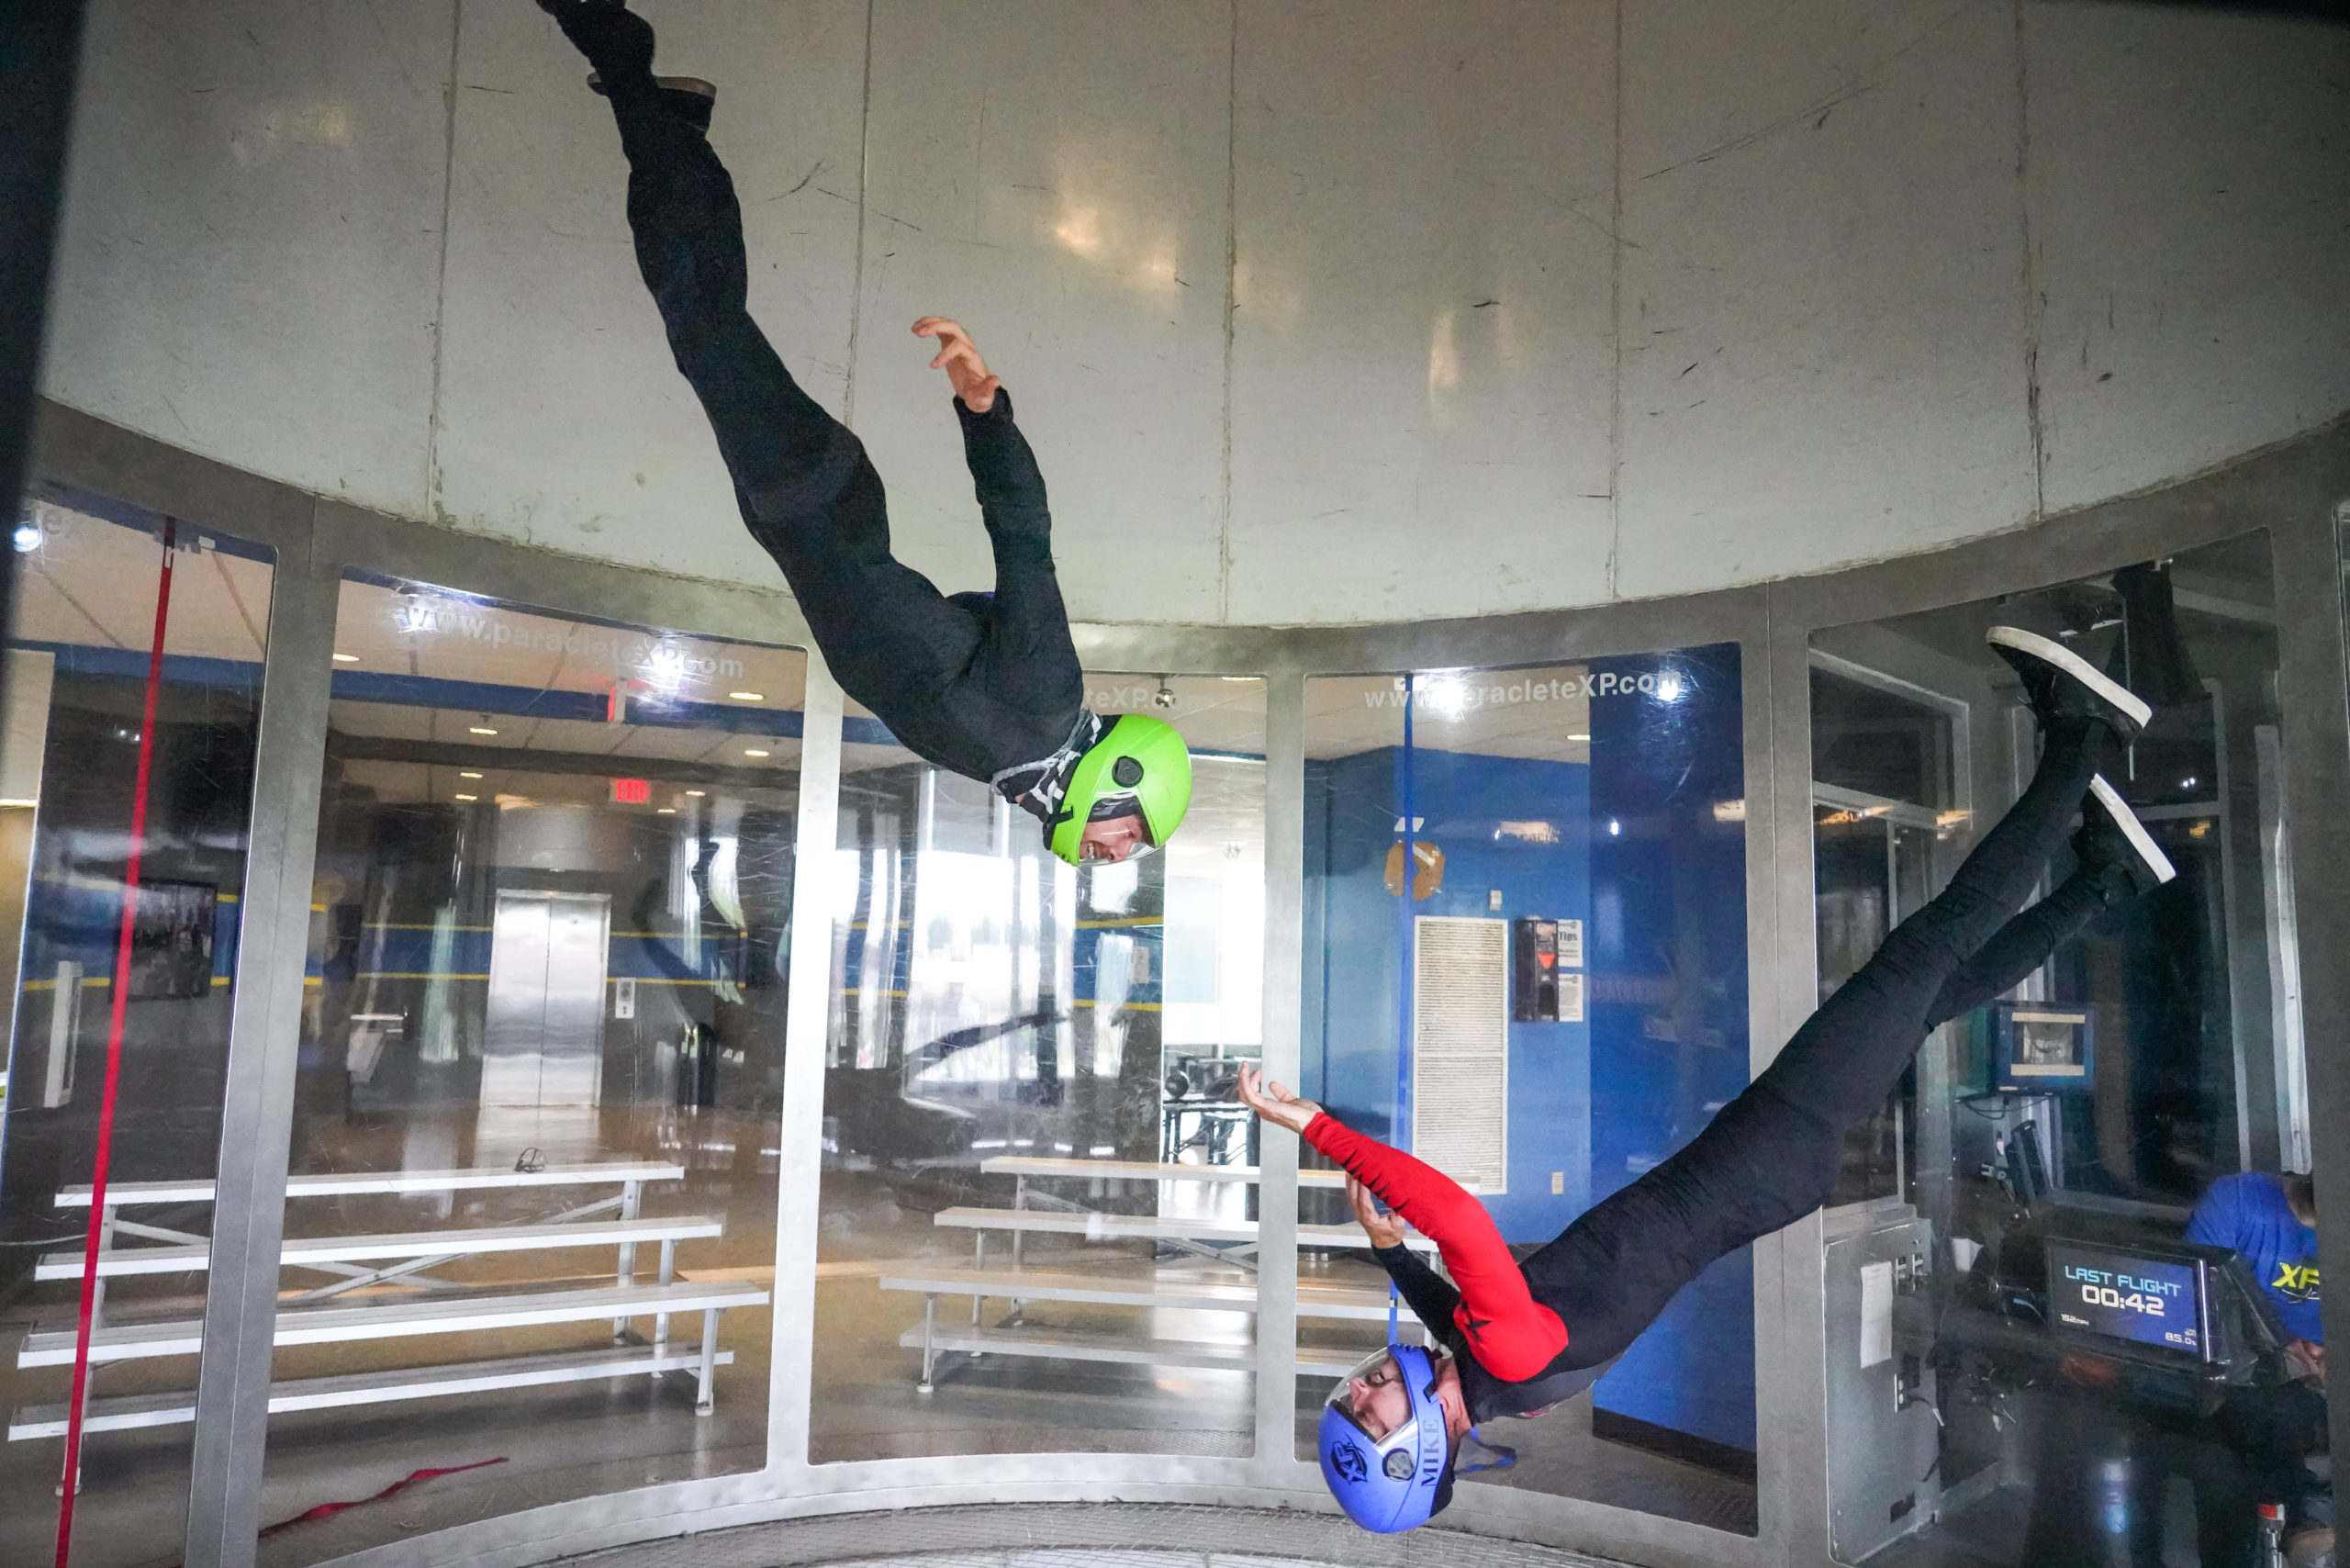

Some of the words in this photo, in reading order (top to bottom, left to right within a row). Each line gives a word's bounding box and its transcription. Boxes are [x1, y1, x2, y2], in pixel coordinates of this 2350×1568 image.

[1364, 671, 1682, 710] www.aracleteXP.com
[2065, 1265, 2112, 1285] LAST
[2117, 1274, 2182, 1297] FLIGHT
[2081, 1284, 2165, 1317] 00:42
[1421, 1419, 1440, 1487] MIKE
